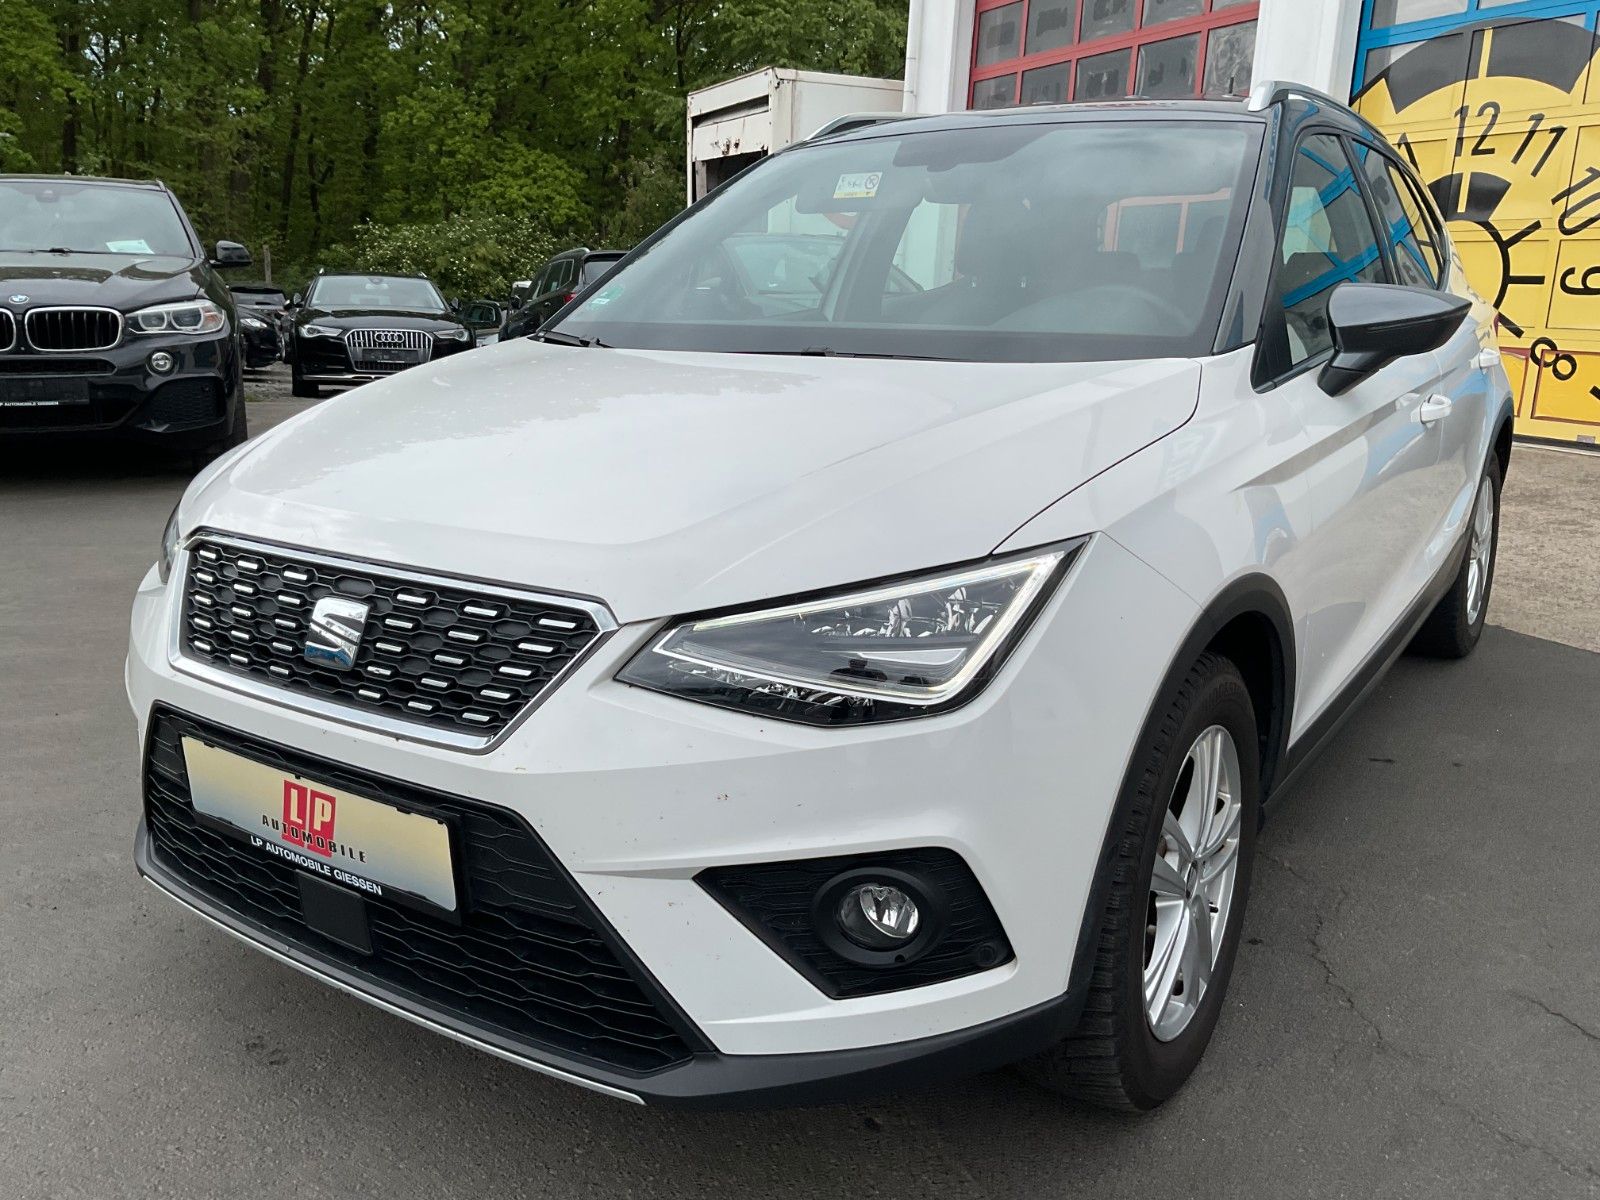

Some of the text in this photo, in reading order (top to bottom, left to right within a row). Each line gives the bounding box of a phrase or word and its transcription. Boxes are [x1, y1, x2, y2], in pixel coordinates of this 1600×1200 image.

[1453, 101, 1500, 157] 12
[1510, 112, 1568, 178] 11
[1551, 166, 1600, 236] 10
[1530, 336, 1577, 381] 8
[288, 785, 334, 832] LP
[250, 835, 383, 896] LP AUTOMOBILE GIESSEN
[261, 814, 368, 864] AUTOMOBILE
